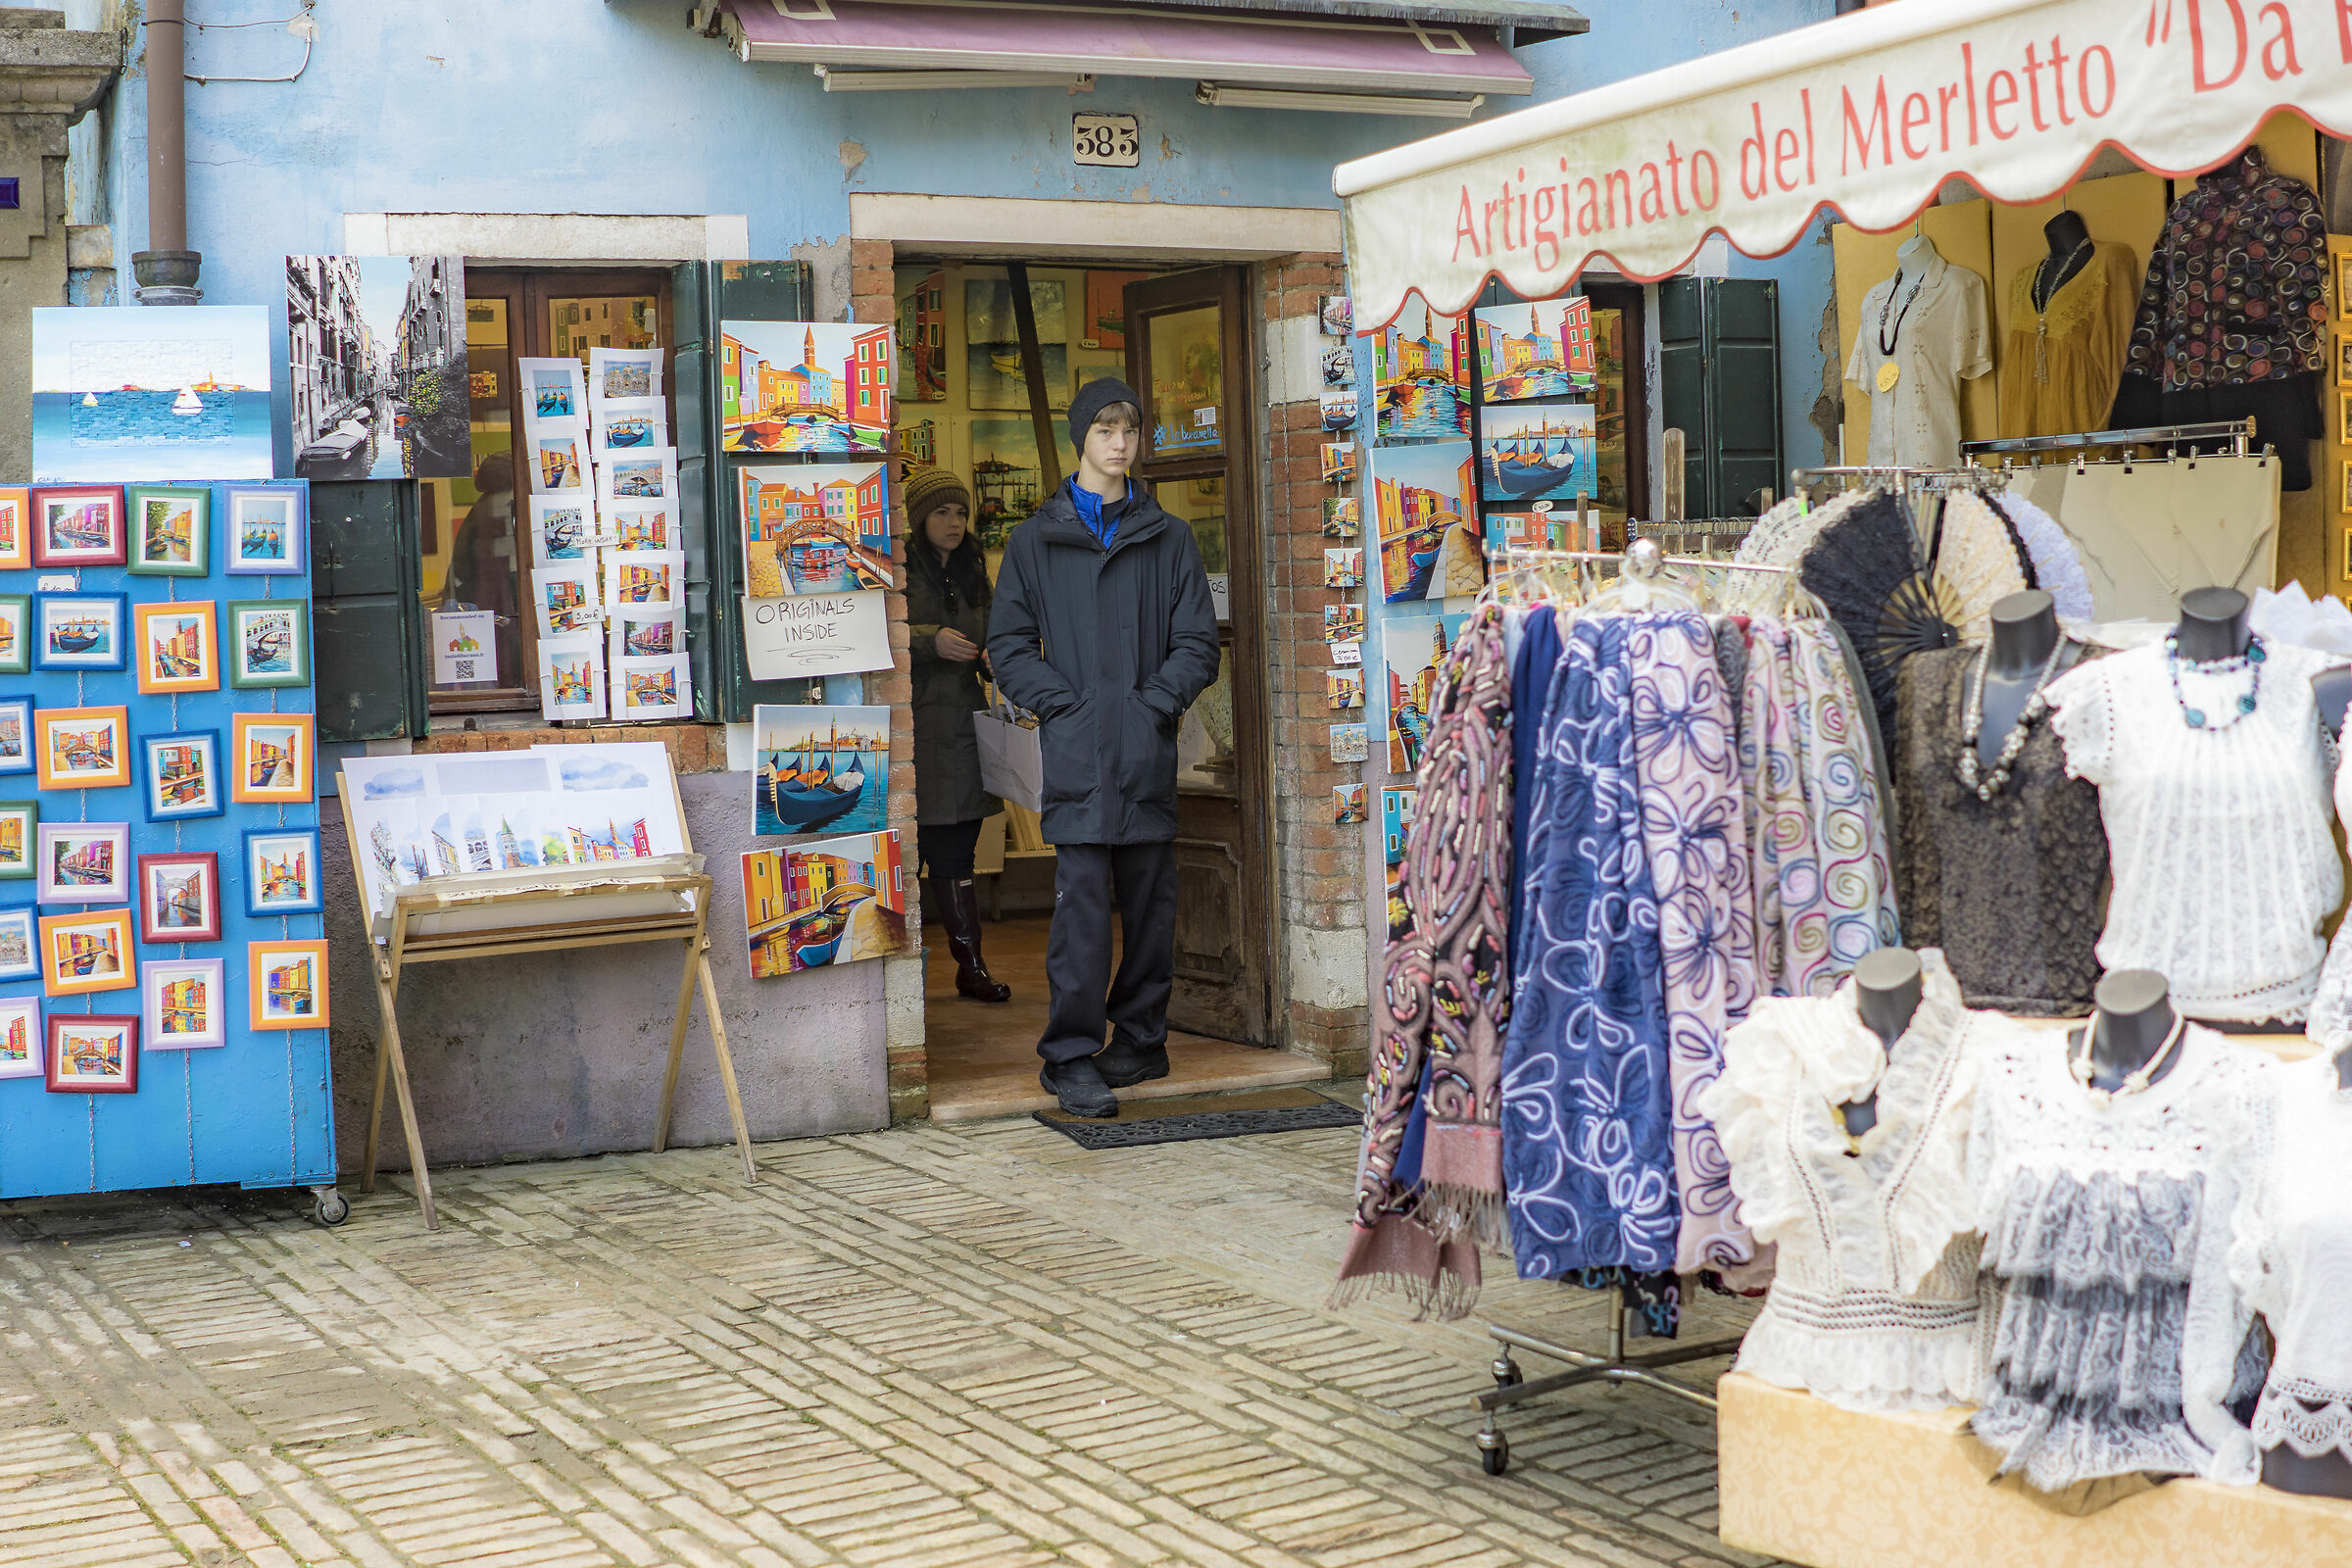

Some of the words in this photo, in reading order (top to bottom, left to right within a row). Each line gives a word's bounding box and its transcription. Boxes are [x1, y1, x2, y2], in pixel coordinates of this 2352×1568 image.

[1076, 125, 1139, 158] 383
[1452, 139, 1719, 272] Artigianato
[1740, 87, 1816, 201] del
[1840, 33, 2117, 177] Merletto
[756, 598, 856, 624] ORIGINALS
[784, 622, 839, 643] INSIDE
